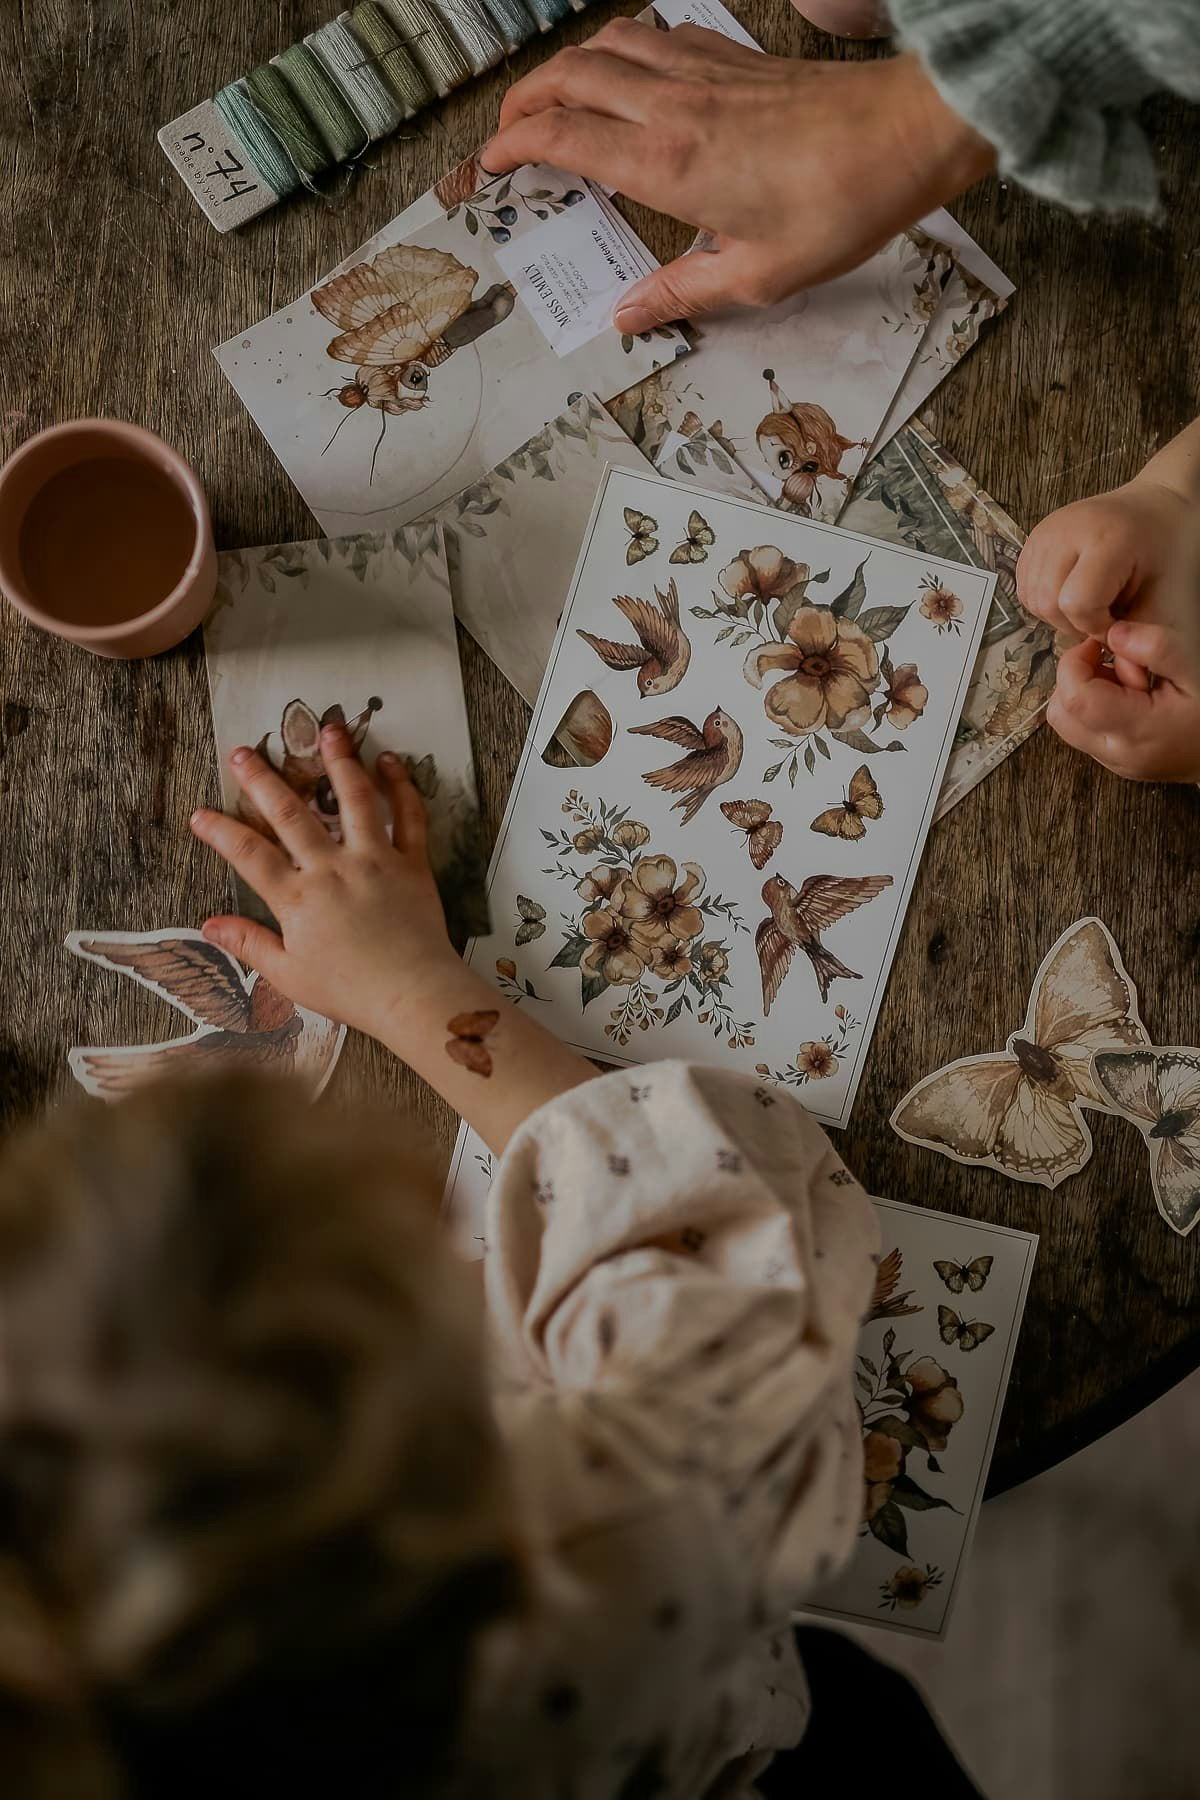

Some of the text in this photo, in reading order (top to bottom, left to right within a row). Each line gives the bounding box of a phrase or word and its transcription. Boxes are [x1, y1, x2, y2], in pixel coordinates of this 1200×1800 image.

[174, 141, 222, 207] made by you
[591, 229, 629, 281] MRS MIGHETTO
[523, 263, 571, 327] MISS EMILY
